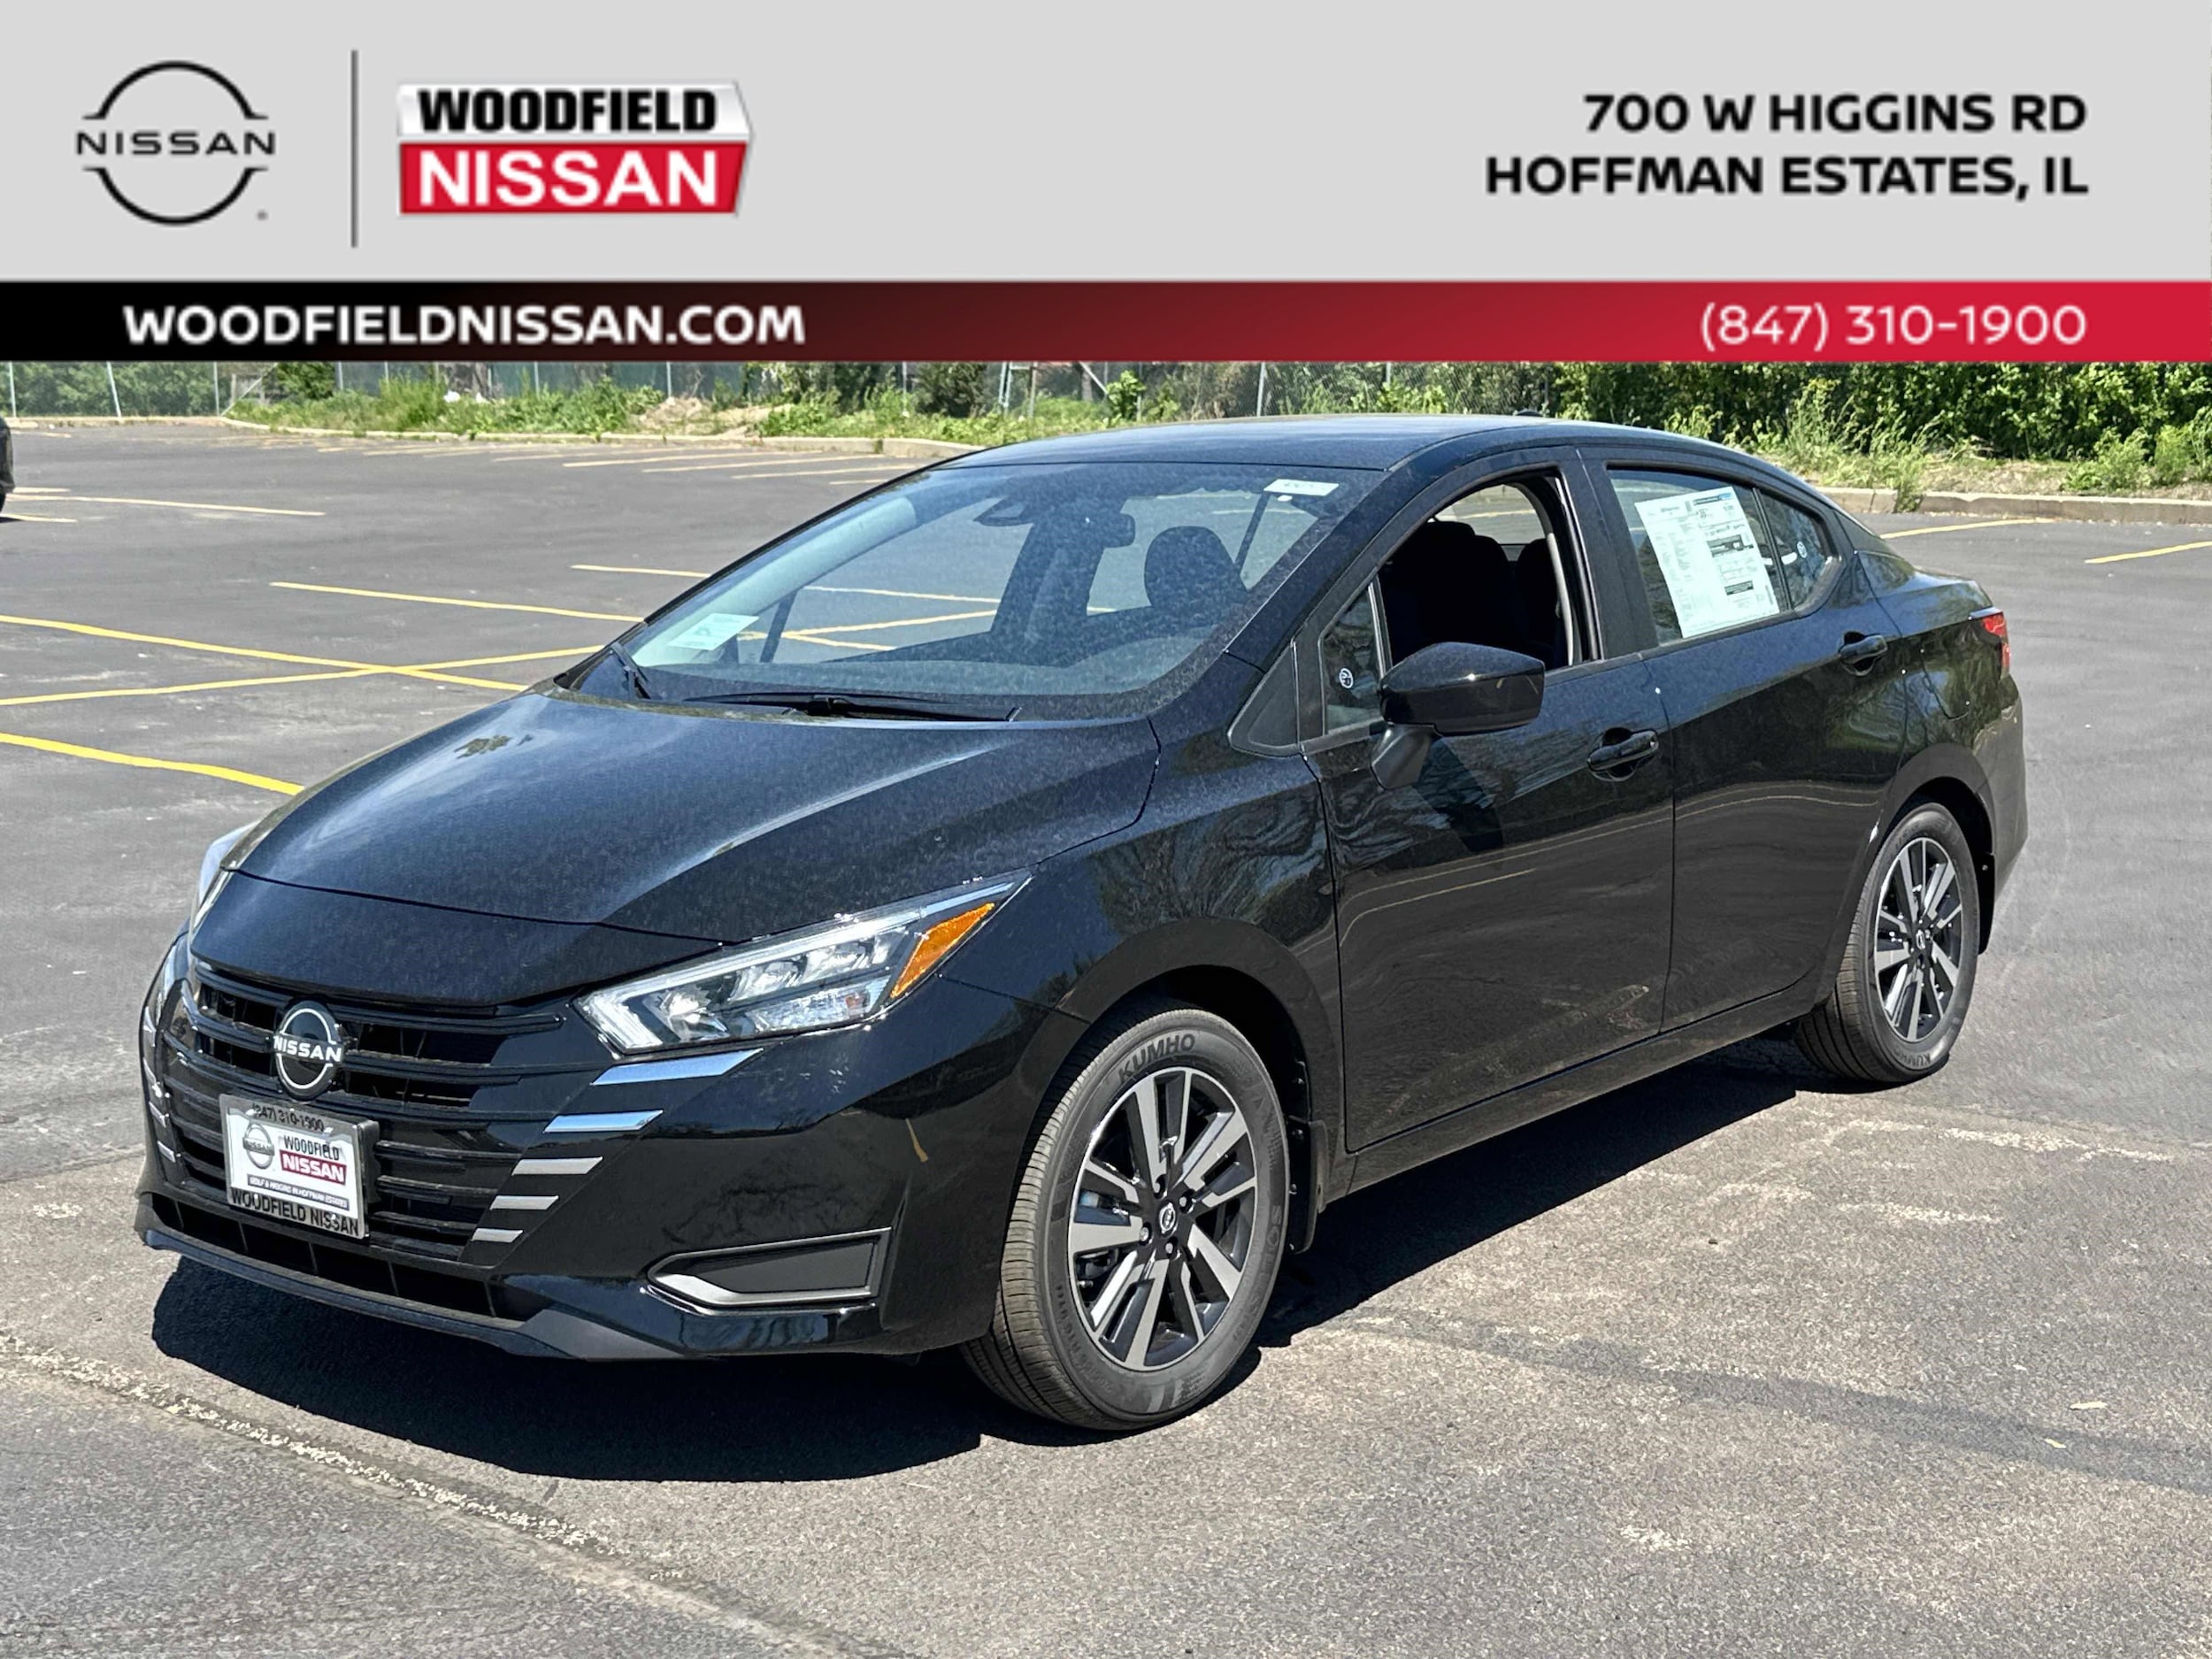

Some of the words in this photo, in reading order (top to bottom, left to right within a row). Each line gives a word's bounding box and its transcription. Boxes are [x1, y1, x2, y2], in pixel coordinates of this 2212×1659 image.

[273, 1034, 342, 1062] NISSAN
[1118, 1033, 1195, 1085] KUMHO
[283, 1134, 340, 1161] WOODFIELD
[283, 1154, 345, 1184] NISSAN
[229, 1187, 307, 1221] WOODFIELD
[311, 1208, 358, 1236] NISSAN
